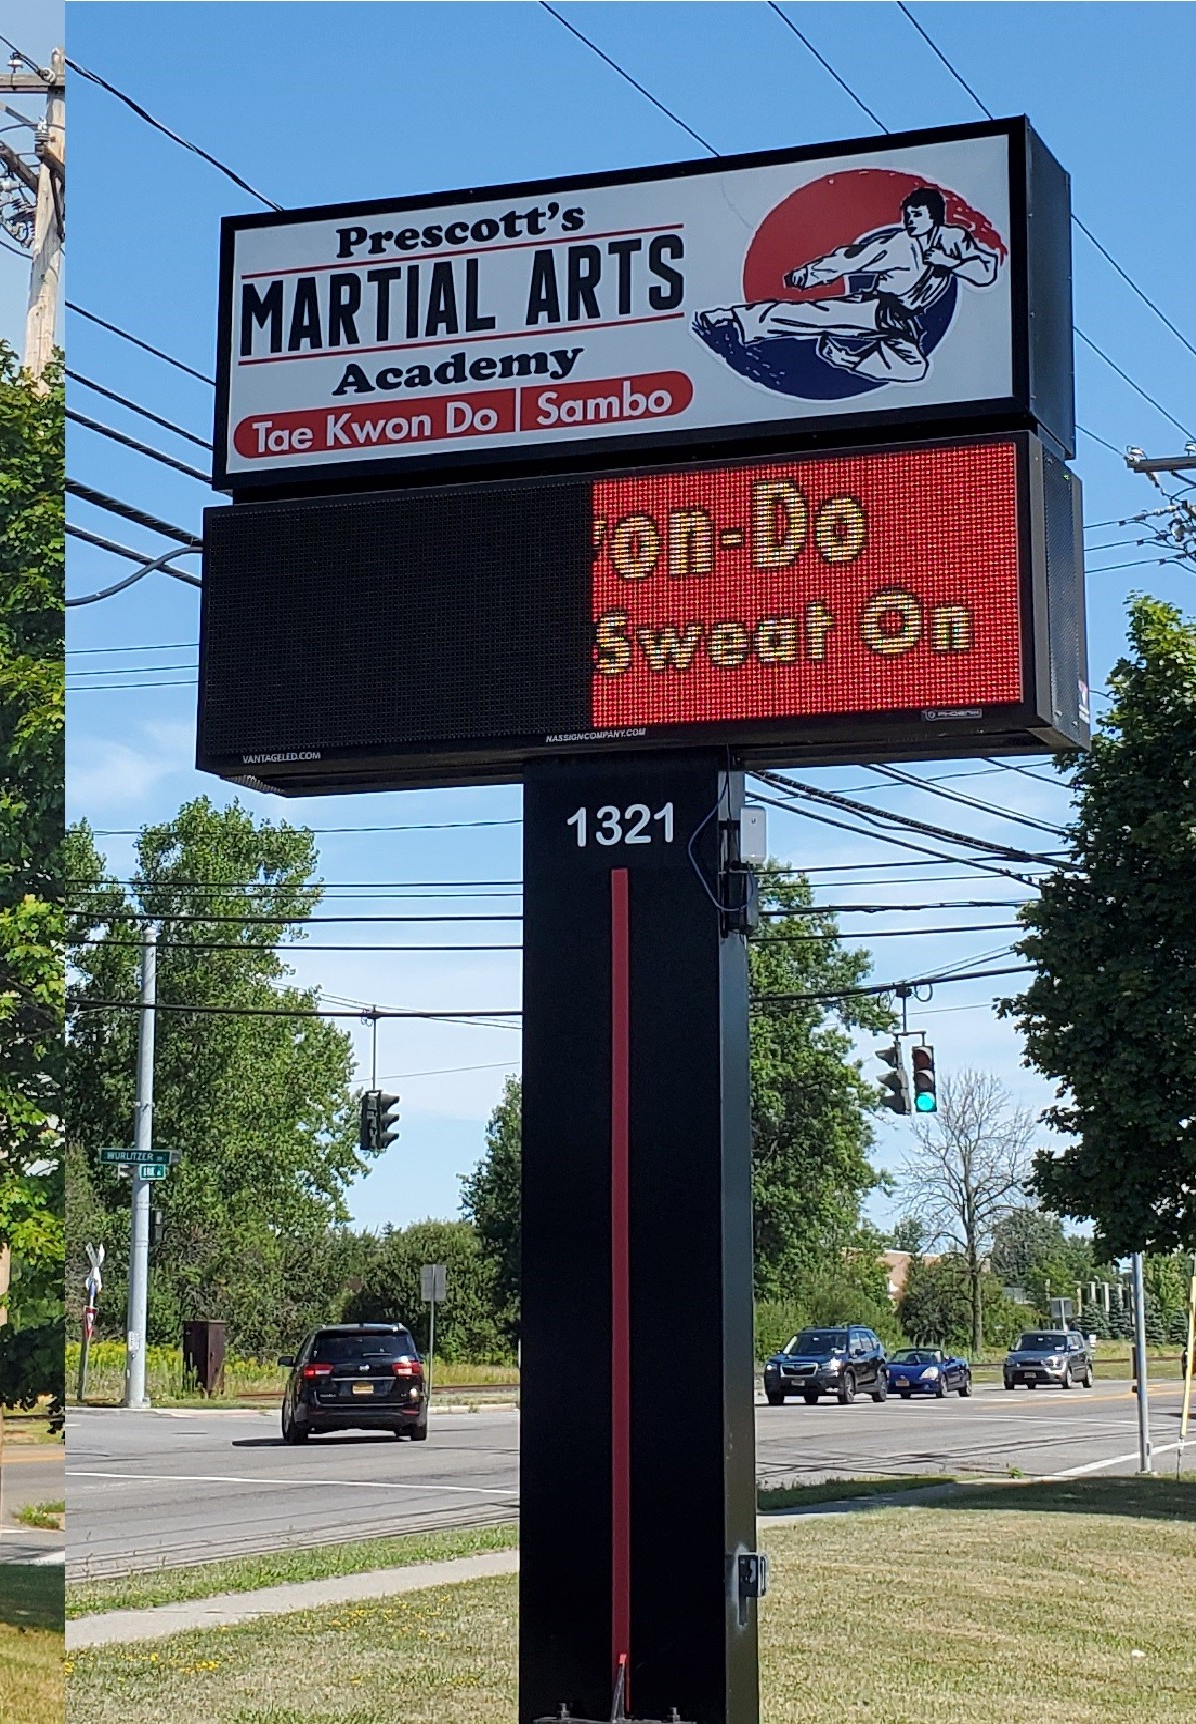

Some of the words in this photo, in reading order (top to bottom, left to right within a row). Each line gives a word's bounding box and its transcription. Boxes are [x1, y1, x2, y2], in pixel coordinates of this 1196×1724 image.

[336, 201, 585, 258] Prescott's
[240, 258, 496, 356] MARTIAL
[525, 233, 685, 326] ARTS
[331, 347, 585, 396] Academy
[252, 420, 313, 453] Tae
[326, 411, 432, 447] Kwon
[446, 400, 498, 434] Do
[536, 381, 673, 426] Sambo
[594, 601, 835, 675] Sweat
[861, 586, 972, 655] On
[242, 751, 321, 764] VANTAGELED.COM
[545, 727, 647, 743] NASSIGNCOMPANY.COM
[566, 801, 674, 848] 1321
